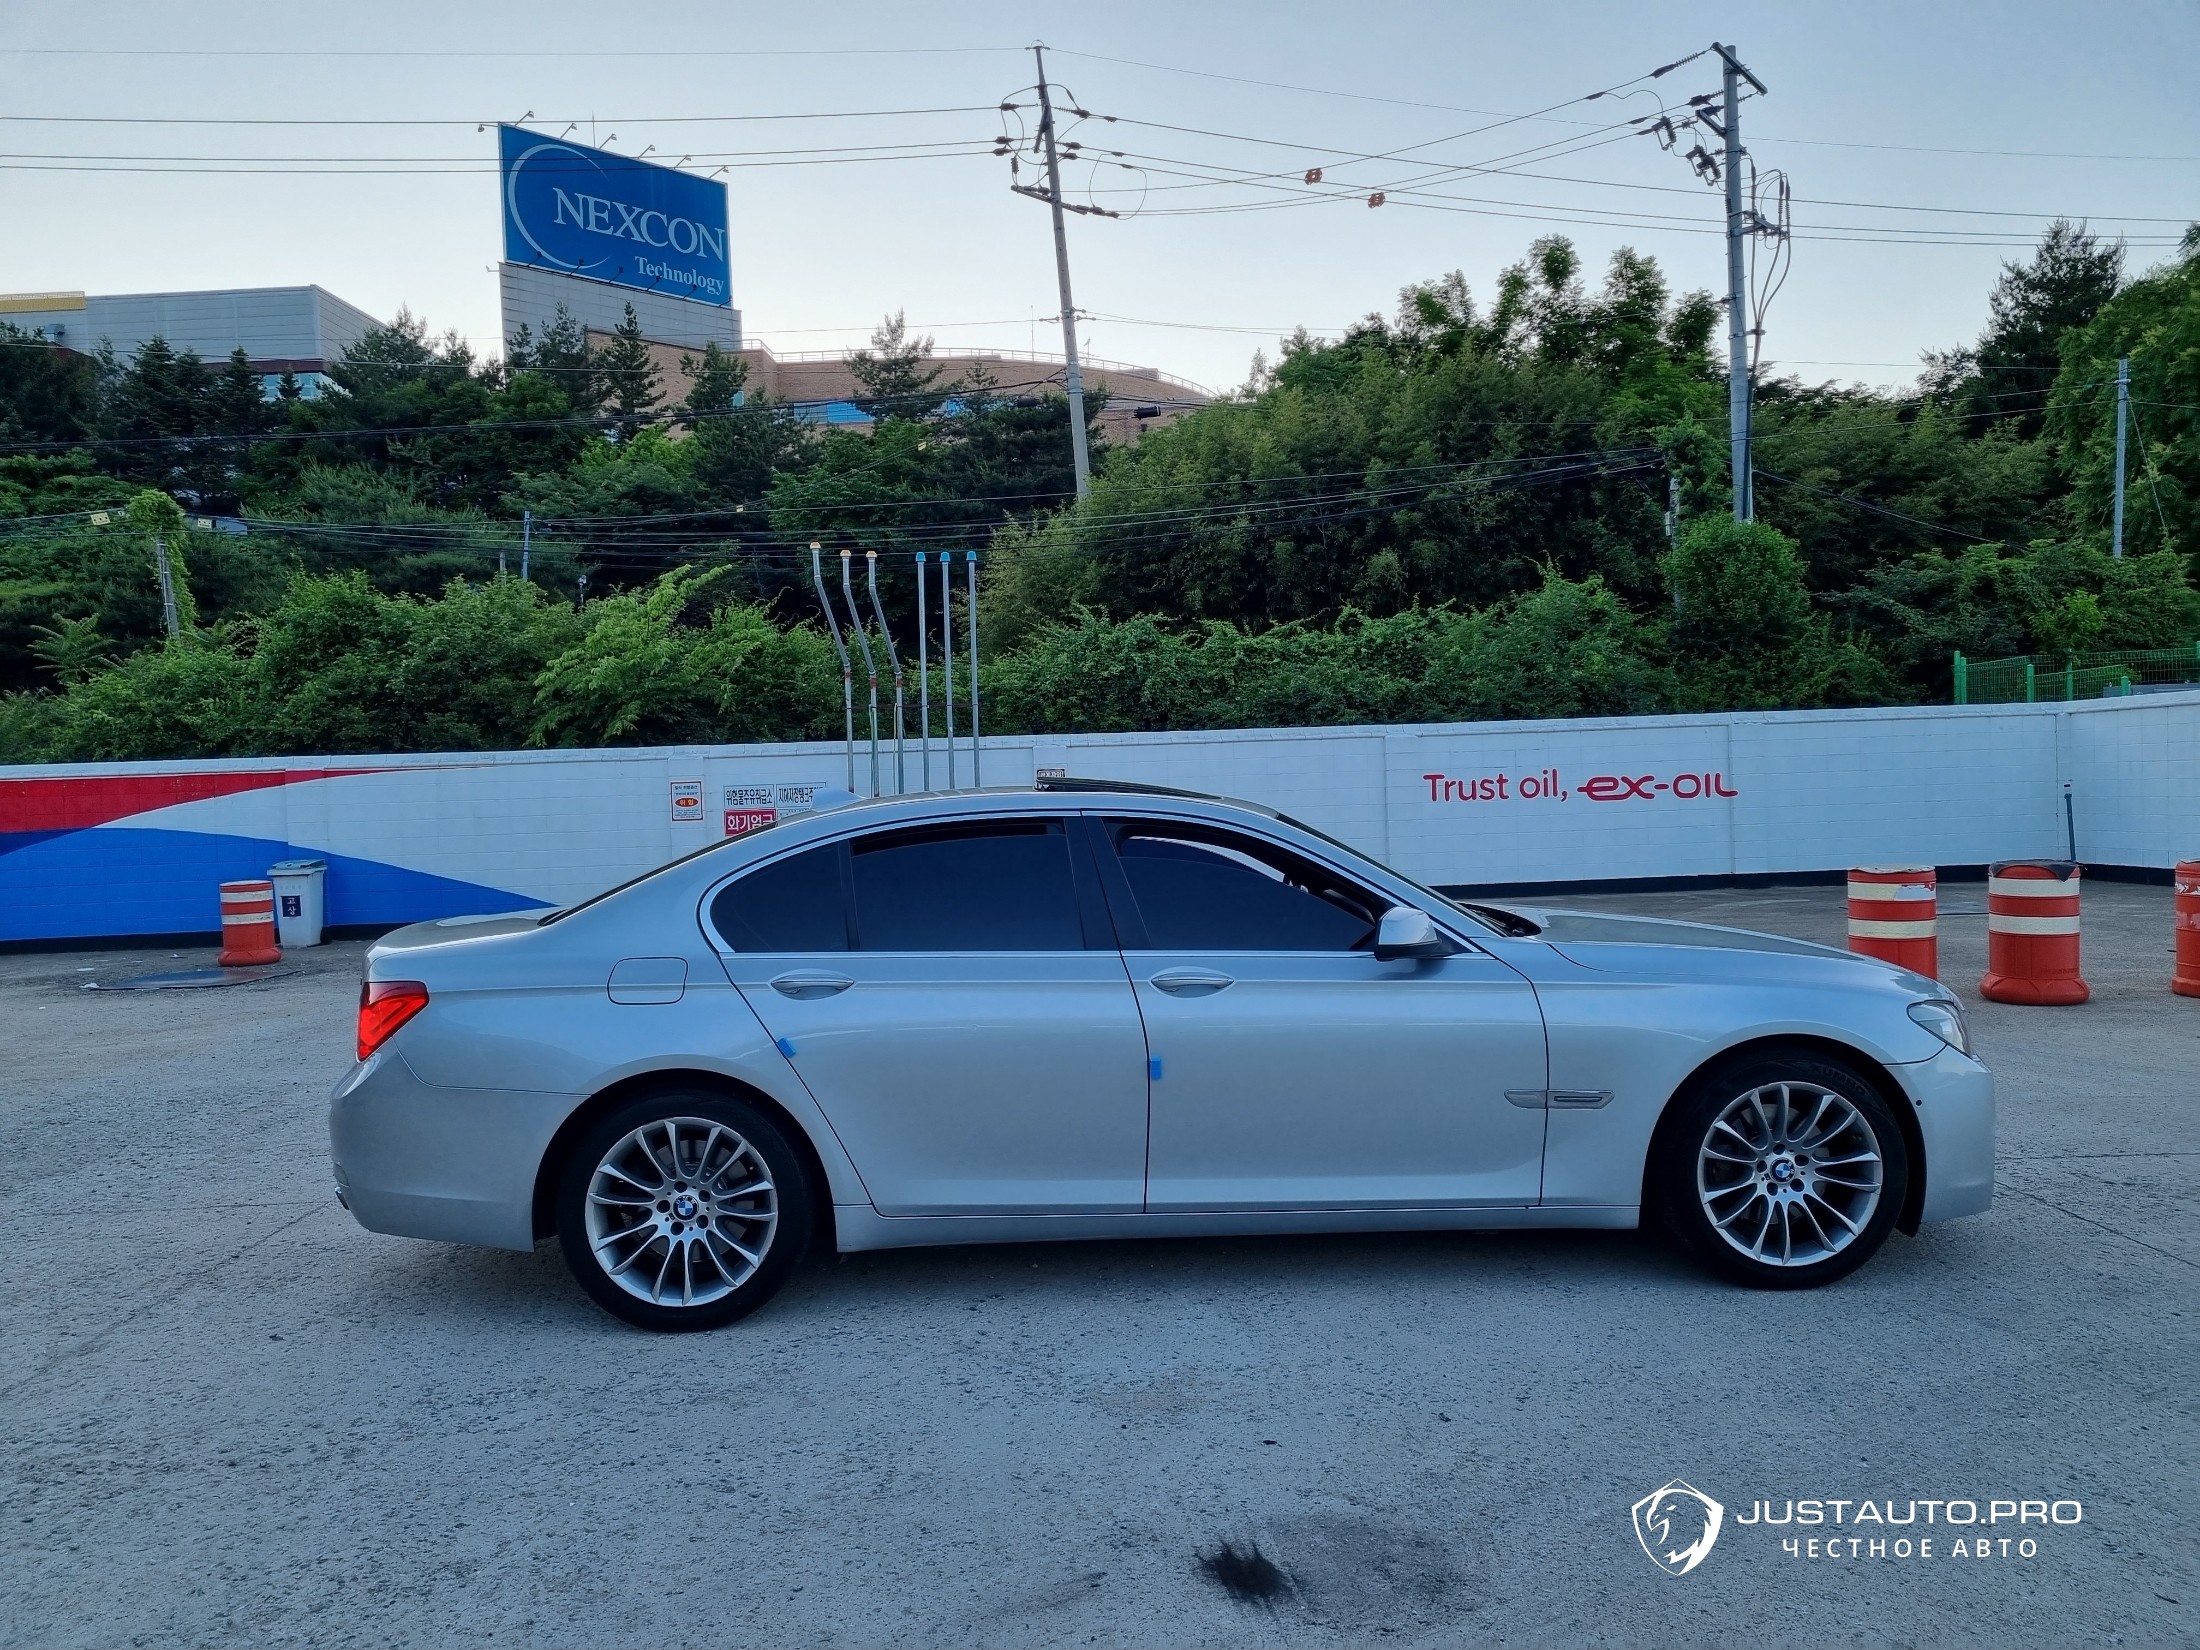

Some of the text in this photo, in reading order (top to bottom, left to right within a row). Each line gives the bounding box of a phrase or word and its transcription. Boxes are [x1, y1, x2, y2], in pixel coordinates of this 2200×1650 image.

[552, 187, 726, 262] NEXCON
[635, 256, 724, 295] Technology
[1423, 773, 1509, 802] Trust
[1519, 768, 1568, 802] oil,
